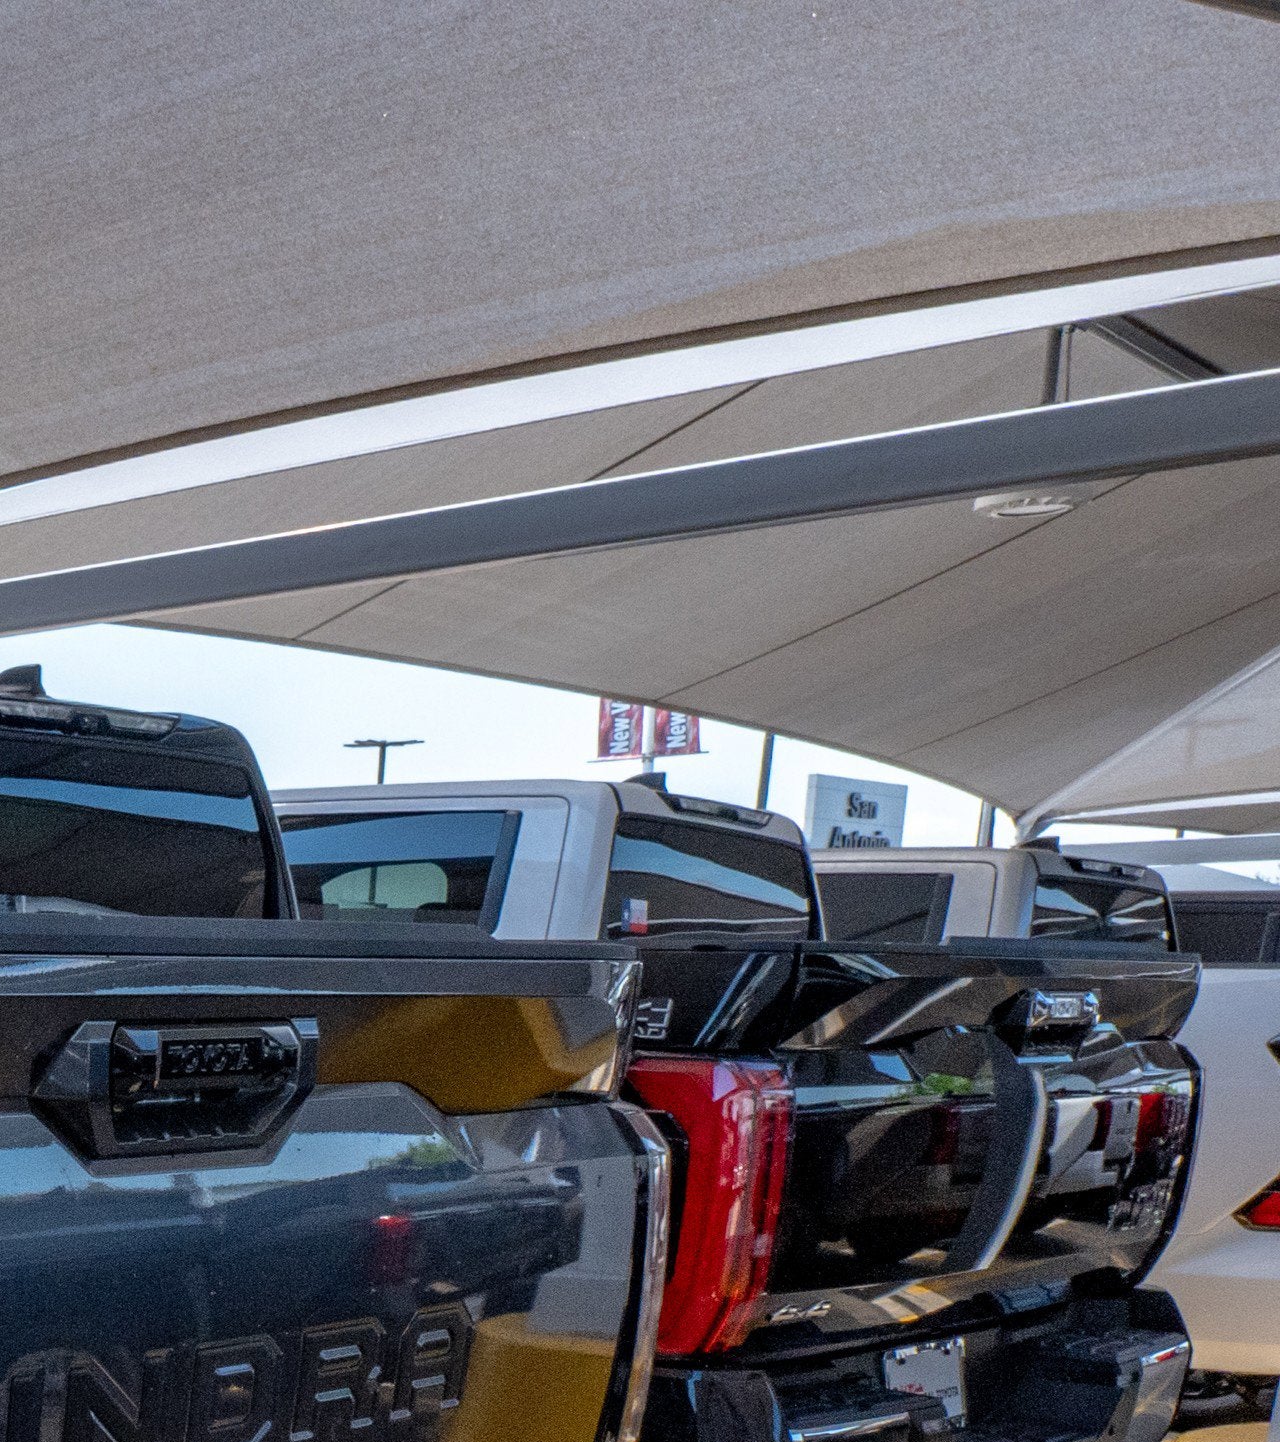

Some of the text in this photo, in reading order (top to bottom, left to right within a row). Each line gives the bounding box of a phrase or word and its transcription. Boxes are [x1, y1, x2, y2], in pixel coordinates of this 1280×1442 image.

[609, 717, 631, 754] New
[666, 711, 687, 749] New
[846, 792, 878, 819] San
[827, 826, 890, 848] Antonio
